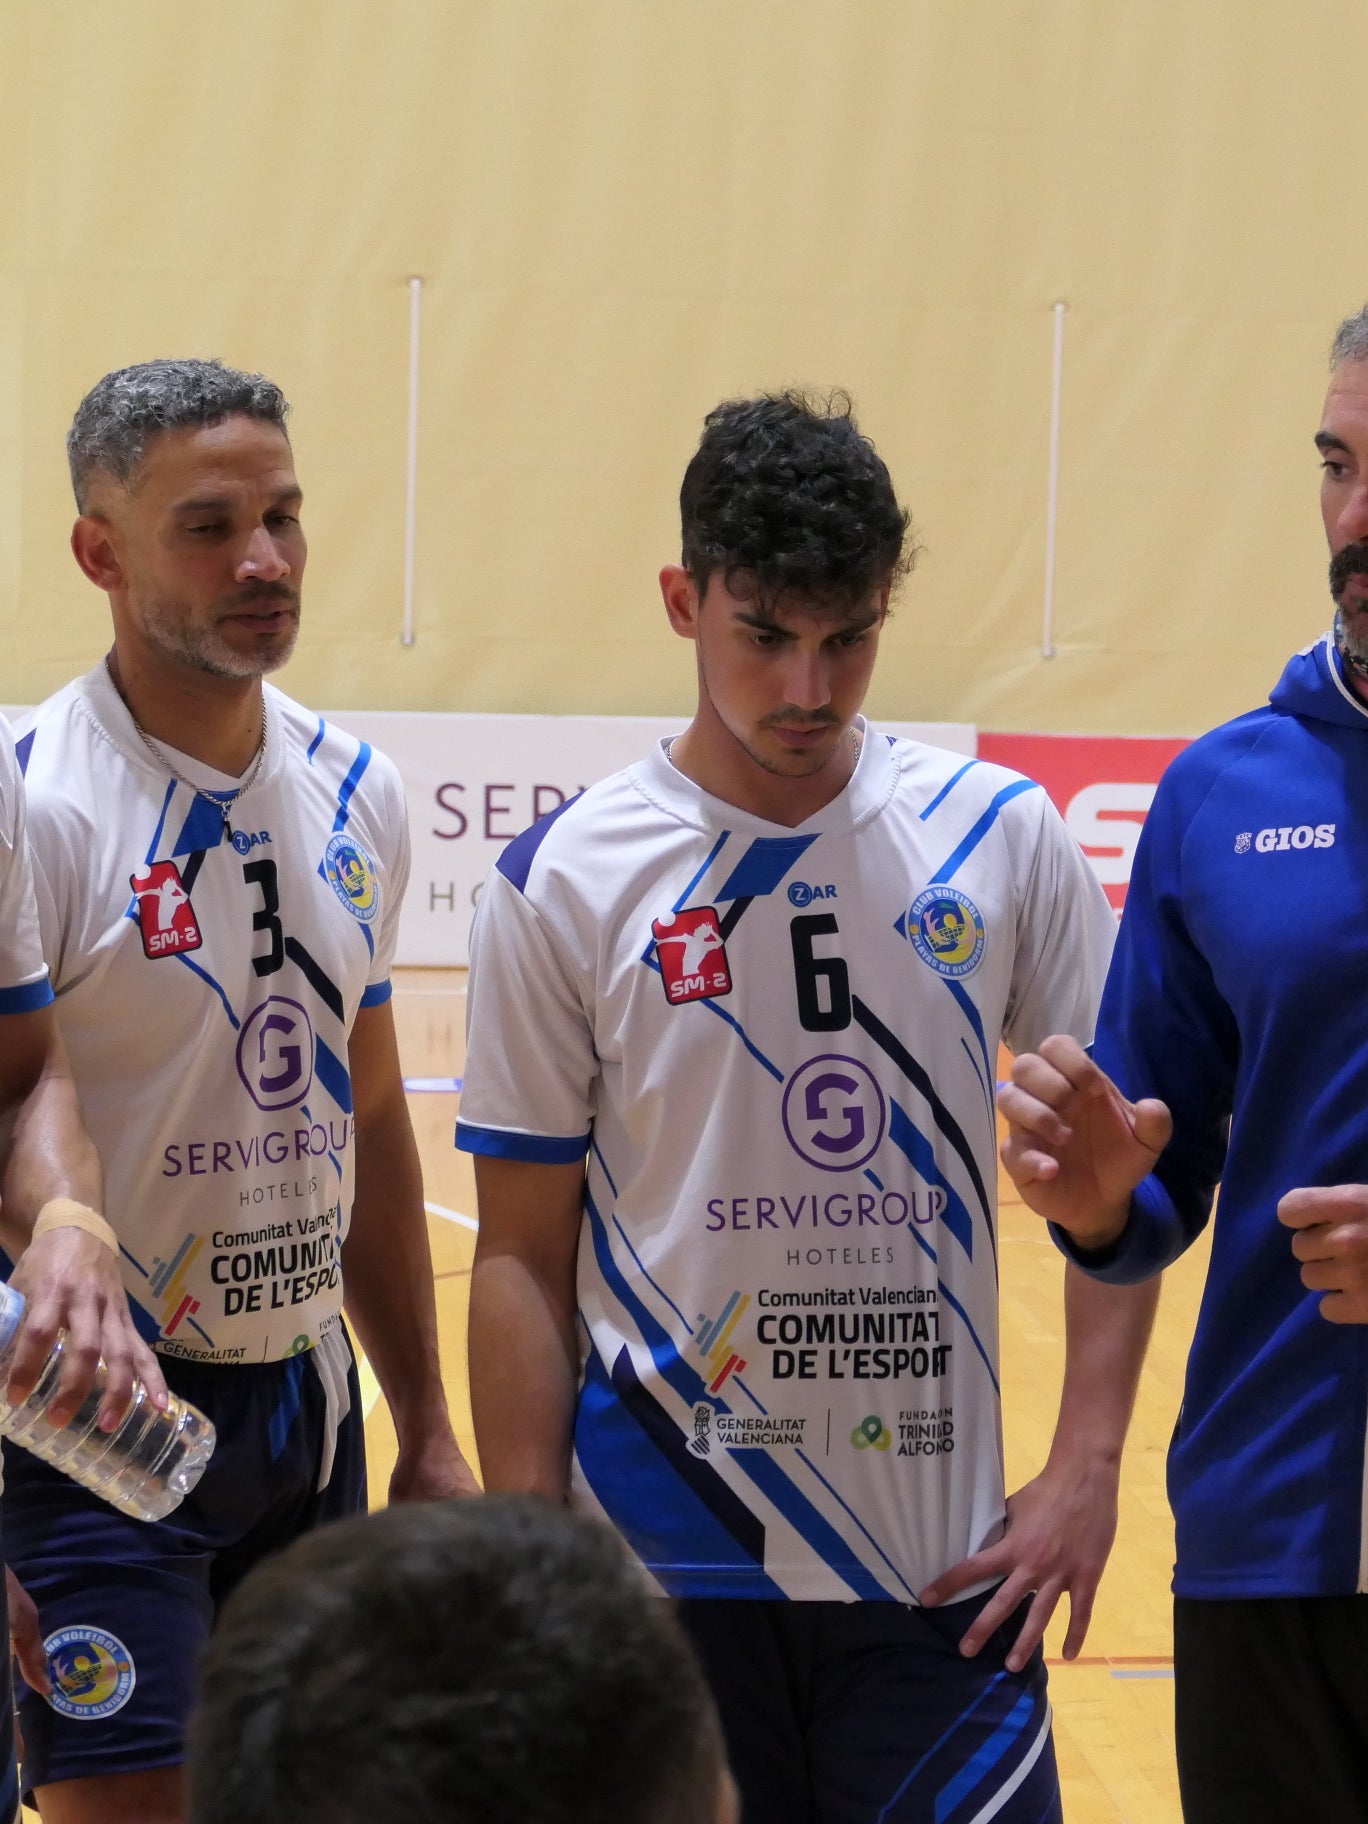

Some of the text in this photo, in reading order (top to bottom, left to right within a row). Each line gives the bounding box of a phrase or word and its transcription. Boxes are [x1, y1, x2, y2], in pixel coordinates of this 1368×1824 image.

[1255, 824, 1336, 853] GIOS
[913, 889, 978, 919] CLUB VOLEIBOL
[243, 859, 284, 978] 3
[149, 926, 198, 952] SM-2
[912, 935, 984, 975] PLAYAS DE BENIDORM
[670, 972, 728, 998] SM-2
[790, 912, 852, 1032] 6
[212, 1221, 292, 1249] Comunitat
[210, 1232, 335, 1285] COMUNIT
[787, 1247, 895, 1266] HOTELES
[224, 1264, 339, 1317] DE L'ESPO
[758, 1286, 938, 1307] Comunitat Valencian
[163, 1342, 247, 1361] GENERALITAT
[772, 1350, 817, 1379] DE
[717, 1418, 807, 1431] GENERALITAT
[717, 1432, 804, 1445] VALENCIANA
[61, 1631, 119, 1653] VOLEIBOL
[76, 1705, 89, 1715] DE
[92, 1672, 130, 1715] BENIDORM
